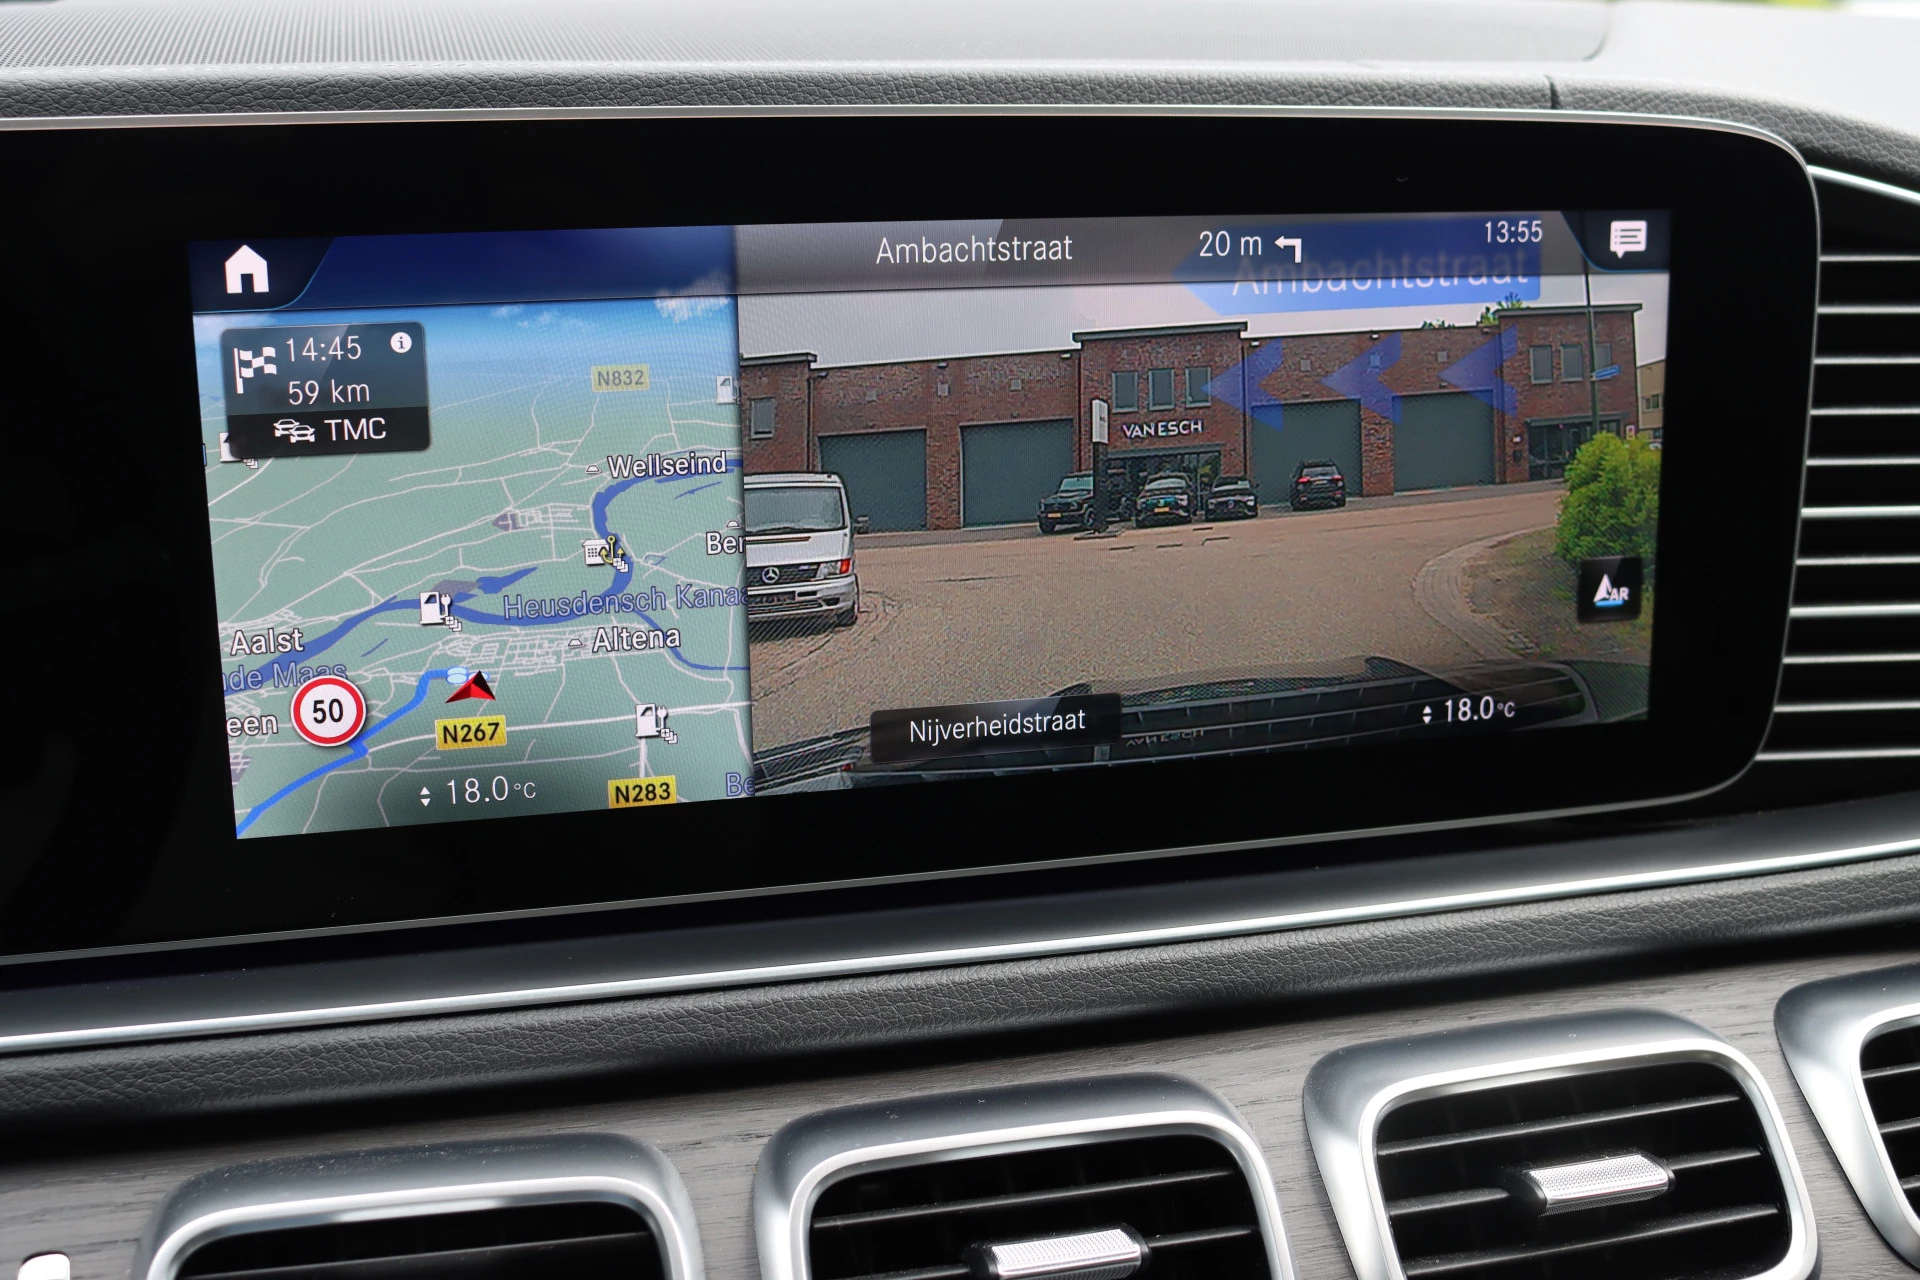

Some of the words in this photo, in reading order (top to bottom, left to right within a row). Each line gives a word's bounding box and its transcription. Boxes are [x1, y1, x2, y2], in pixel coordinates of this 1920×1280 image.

[1199, 230, 1231, 257] 20
[1240, 235, 1262, 256] m
[1484, 220, 1543, 244] 13:55
[875, 234, 1073, 264] Ambachtstraat
[1231, 247, 1530, 296] Ambachtstraat
[285, 335, 362, 363] 14:45
[288, 381, 320, 405] 59
[331, 379, 370, 403] km
[597, 370, 645, 387] N832
[324, 417, 387, 441] TMC
[607, 451, 727, 478] Wellseind
[503, 587, 667, 619] Heusdensch
[1609, 587, 1629, 600] AR
[230, 628, 304, 656] Aalst
[592, 626, 681, 653] Altena
[312, 698, 344, 724] 50
[443, 722, 500, 744] N267
[910, 709, 1086, 746] Nijverheidstraat
[615, 783, 671, 803] N283
